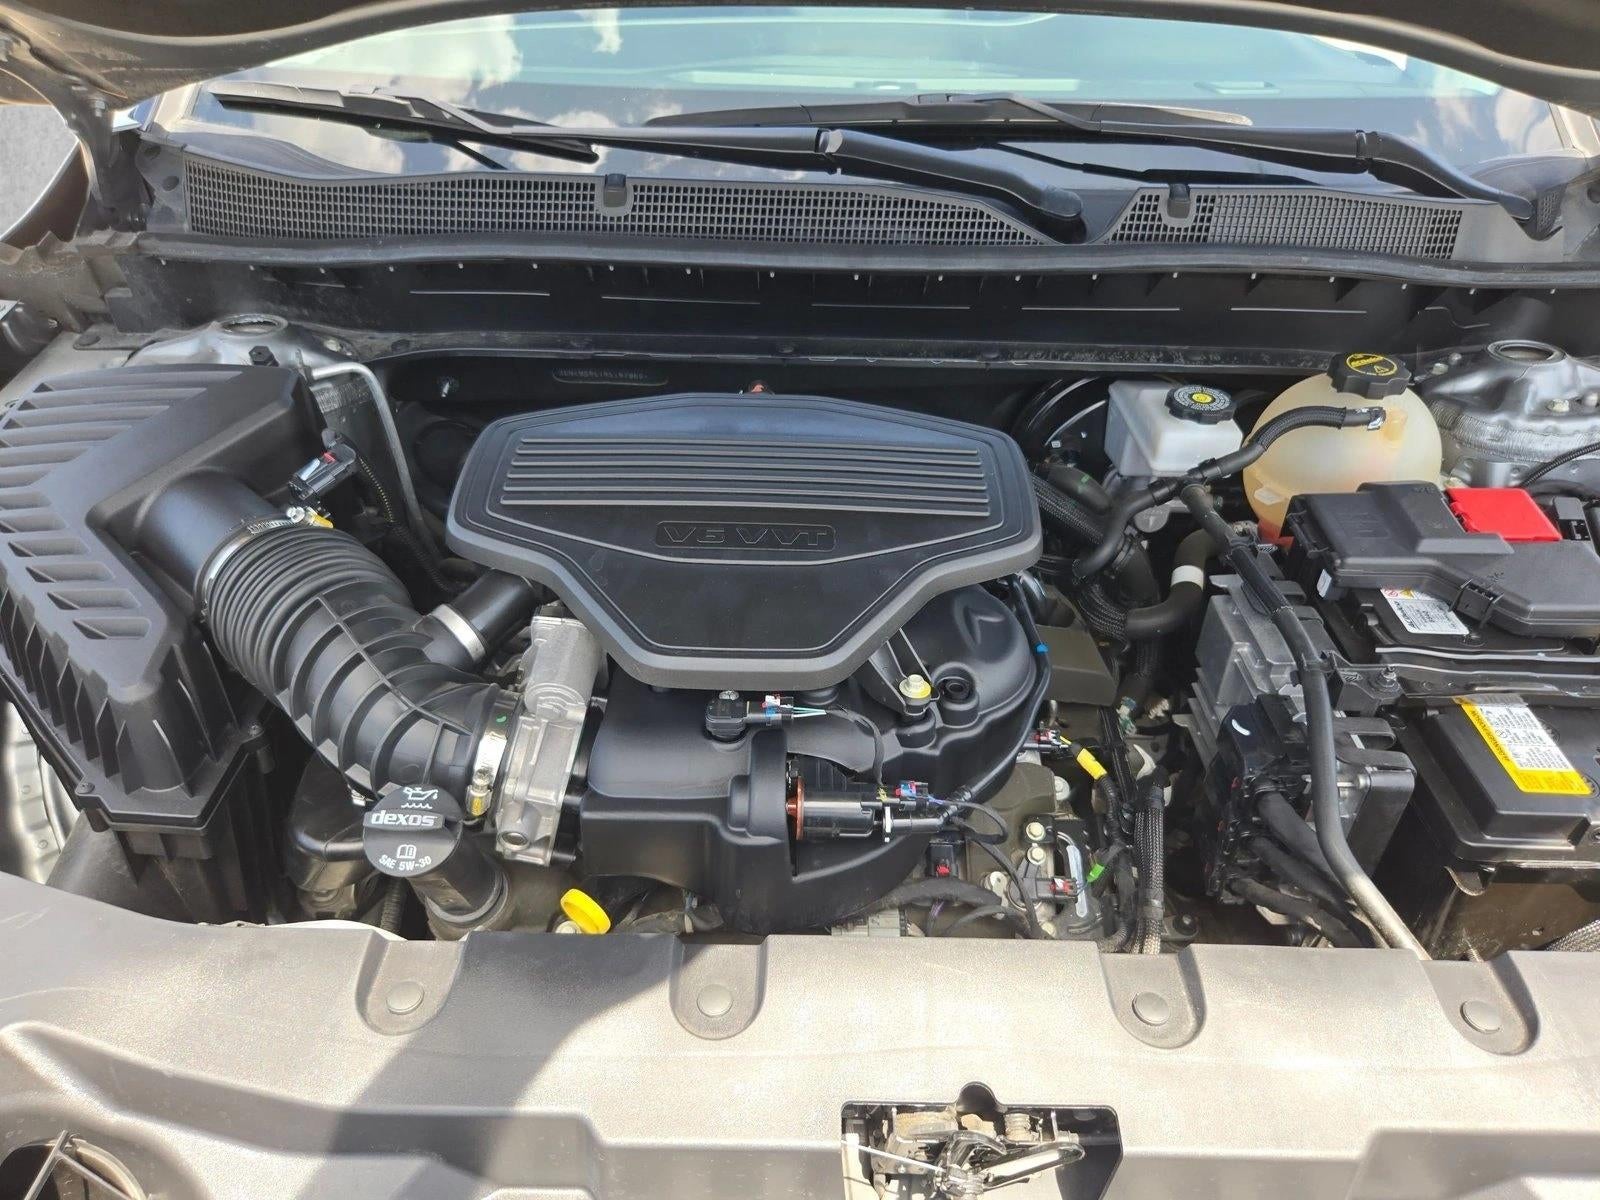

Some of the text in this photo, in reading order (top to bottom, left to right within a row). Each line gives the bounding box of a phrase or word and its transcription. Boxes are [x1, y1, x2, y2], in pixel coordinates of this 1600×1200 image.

[663, 526, 828, 546] V6 VVT
[371, 809, 438, 827] dexos
[378, 854, 432, 871] SAE 5W-30
